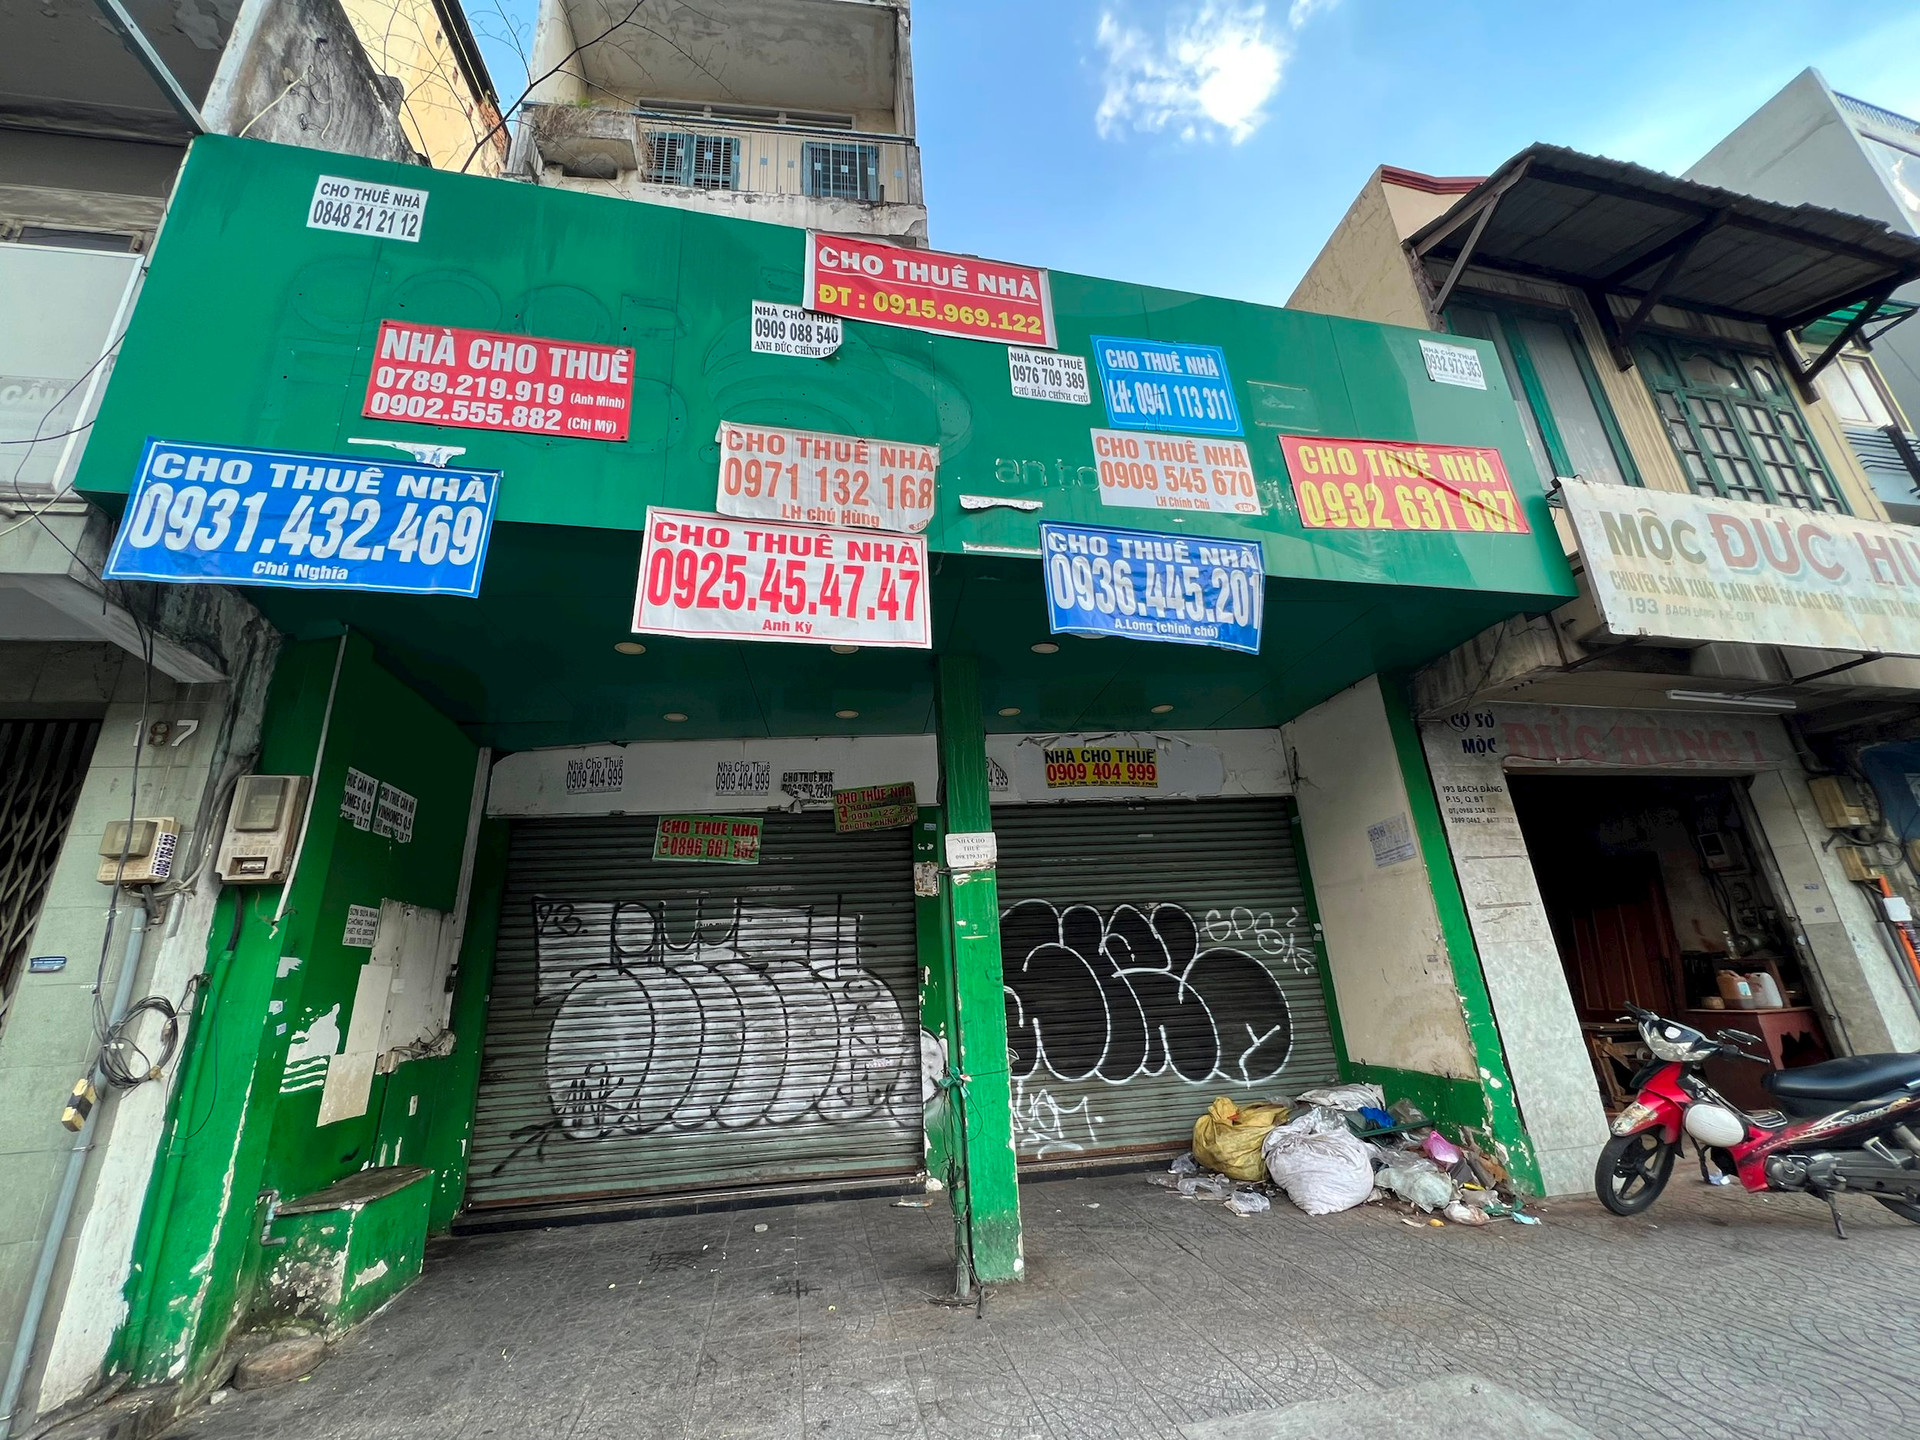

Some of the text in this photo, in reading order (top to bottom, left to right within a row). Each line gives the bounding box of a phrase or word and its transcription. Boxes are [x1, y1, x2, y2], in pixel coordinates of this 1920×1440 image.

[320, 182, 350, 198] CHO
[354, 188, 391, 205] THUÊ
[392, 193, 420, 209] NHÀ
[313, 199, 352, 227] 0848
[353, 206, 373, 230] 21
[375, 209, 396, 234] 21
[401, 212, 419, 237] 12
[818, 246, 1039, 300] CHO THUÊ NHÀ
[754, 305, 806, 320] NHÀ CHO
[818, 283, 852, 307] ĐT
[872, 291, 1041, 335] 0915.969.122
[755, 317, 839, 344] 0909 088 540
[380, 328, 630, 385] NHÀ CHO THUÊ
[754, 340, 820, 356] ANH ĐỨC CHÍNH
[1010, 351, 1083, 370] NHÀ CHO THUÊ
[1105, 348, 1220, 377] CHO THUÊ NHÀ
[375, 366, 626, 410] 0789.219.919 (Anh Minh)
[1012, 364, 1085, 390] 0976 709 389
[370, 391, 618, 434] 0902.555.882 (Chị Mỹ)
[1134, 381, 1173, 416] 0941
[1173, 385, 1204, 419] 113
[1202, 387, 1232, 420] 311
[725, 430, 934, 472] CHO THUÊ NHÀ
[1095, 436, 1248, 468] CHO THUÊ NHÀ
[1298, 445, 1496, 482] CHO THUÊ NHÀ
[151, 452, 488, 504] CHO THUÊ NHÀ
[724, 457, 933, 510] 0971 132 168
[1101, 461, 1254, 497] 0909 545 670
[1156, 495, 1167, 507] LH
[1300, 480, 1393, 530] 0932
[1394, 484, 1457, 531] 631
[128, 482, 484, 566] 0931.432.469
[782, 503, 880, 528] LH chú Hùng
[654, 521, 919, 566] CHO THUÊ NHÀ
[1047, 532, 1260, 570] CHO THUÊ NHÀ
[1598, 507, 1846, 581] MỘC ĐỨC
[252, 559, 349, 582] Chú Nghĩa
[647, 547, 920, 621] 0925.45.47.47
[1050, 553, 1260, 630] 0936.445.201
[1628, 597, 1660, 614] 193
[762, 620, 790, 632] Anh
[1114, 618, 1154, 633] A.Long
[1044, 748, 1156, 764] NHÀ CHO THUÊ
[1461, 735, 1497, 758] MỘC
[568, 759, 583, 770] Nhà
[586, 757, 602, 769] Cho
[718, 761, 732, 772] Nhà
[735, 761, 750, 772] Cho
[782, 771, 798, 783] CHO
[1047, 763, 1156, 781] 0909 404 999
[566, 768, 623, 789] 0909 404 999
[716, 772, 770, 790] 0909 404 999
[836, 792, 857, 805] CHO
[661, 820, 759, 837] CHO THUÊ NHÀ
[670, 837, 729, 858] 0896 661
